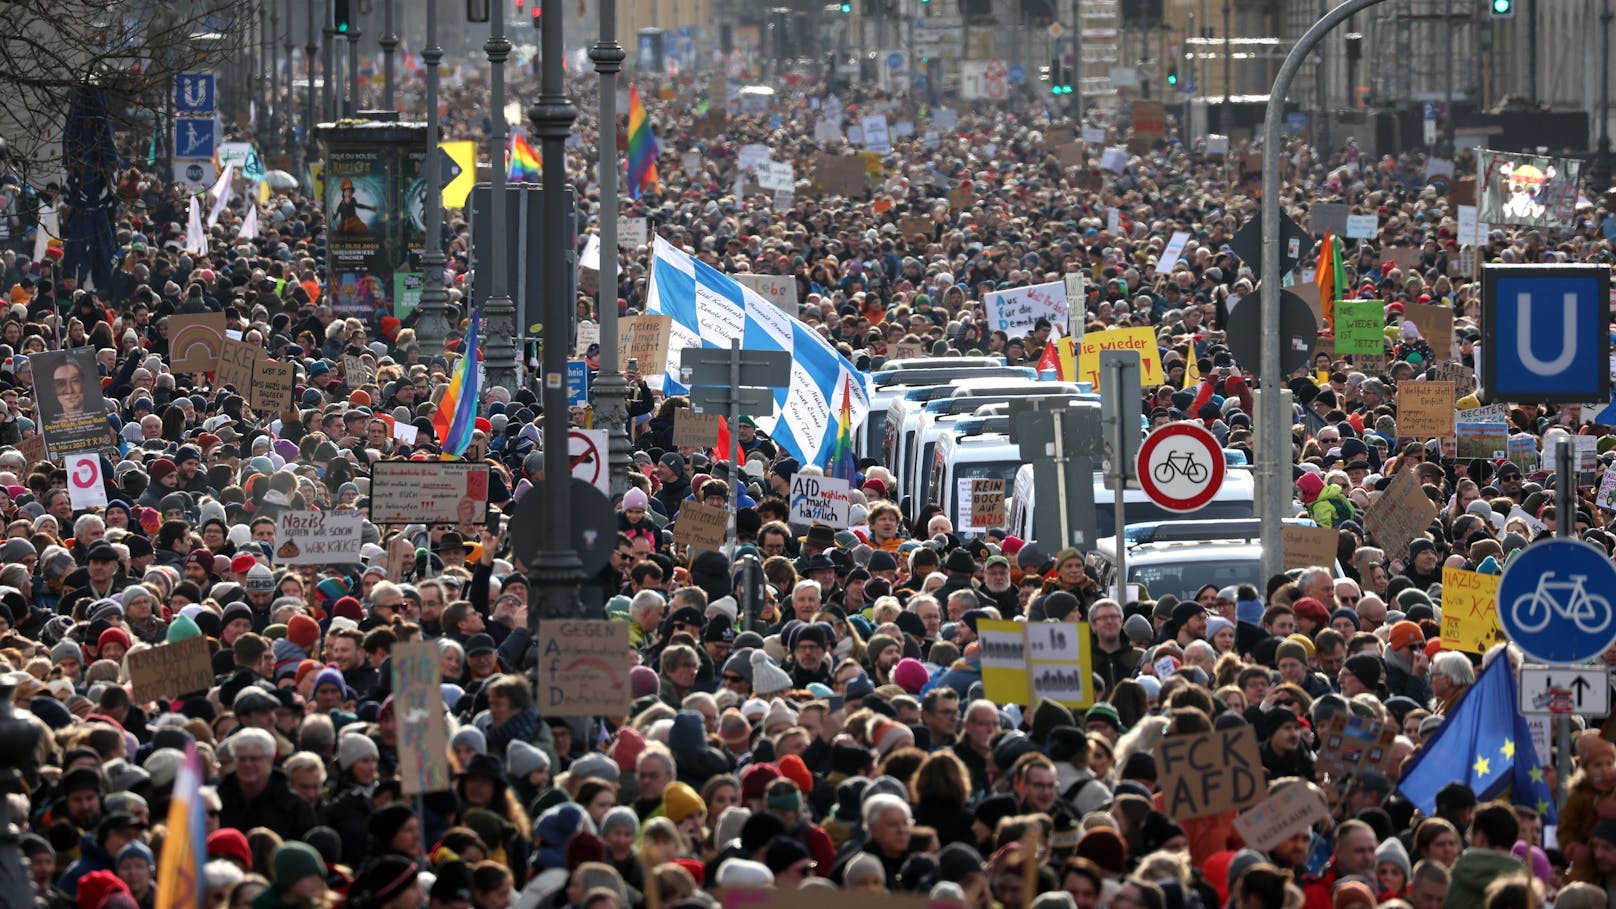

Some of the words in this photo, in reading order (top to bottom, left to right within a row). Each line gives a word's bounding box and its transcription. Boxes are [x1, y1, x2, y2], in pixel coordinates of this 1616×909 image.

[184, 77, 206, 107] U
[186, 167, 204, 178] BUS
[1340, 307, 1352, 315] NIE
[1346, 320, 1379, 328] WIEDER
[621, 333, 660, 342] Heimat
[1340, 331, 1351, 339] IST
[1517, 292, 1577, 377] U
[631, 342, 659, 352] nicht
[1100, 336, 1148, 351] wieder
[1353, 339, 1380, 348] JETZT
[1404, 387, 1432, 396] Vielfalt
[1435, 386, 1450, 394] statt
[1461, 404, 1504, 419] RECHTER
[792, 478, 820, 497] AfD
[975, 480, 1002, 492] KEIN
[807, 499, 831, 508] macht
[974, 494, 1001, 503] BOCK
[978, 504, 997, 512] AUF
[283, 512, 326, 529] Nazis?
[974, 513, 1003, 525] NAZIS
[1444, 572, 1481, 589] NAZIS
[1469, 595, 1498, 620] KA
[560, 623, 615, 638] GEGEN
[1161, 731, 1249, 775] FCK
[1171, 766, 1257, 817] AFD
